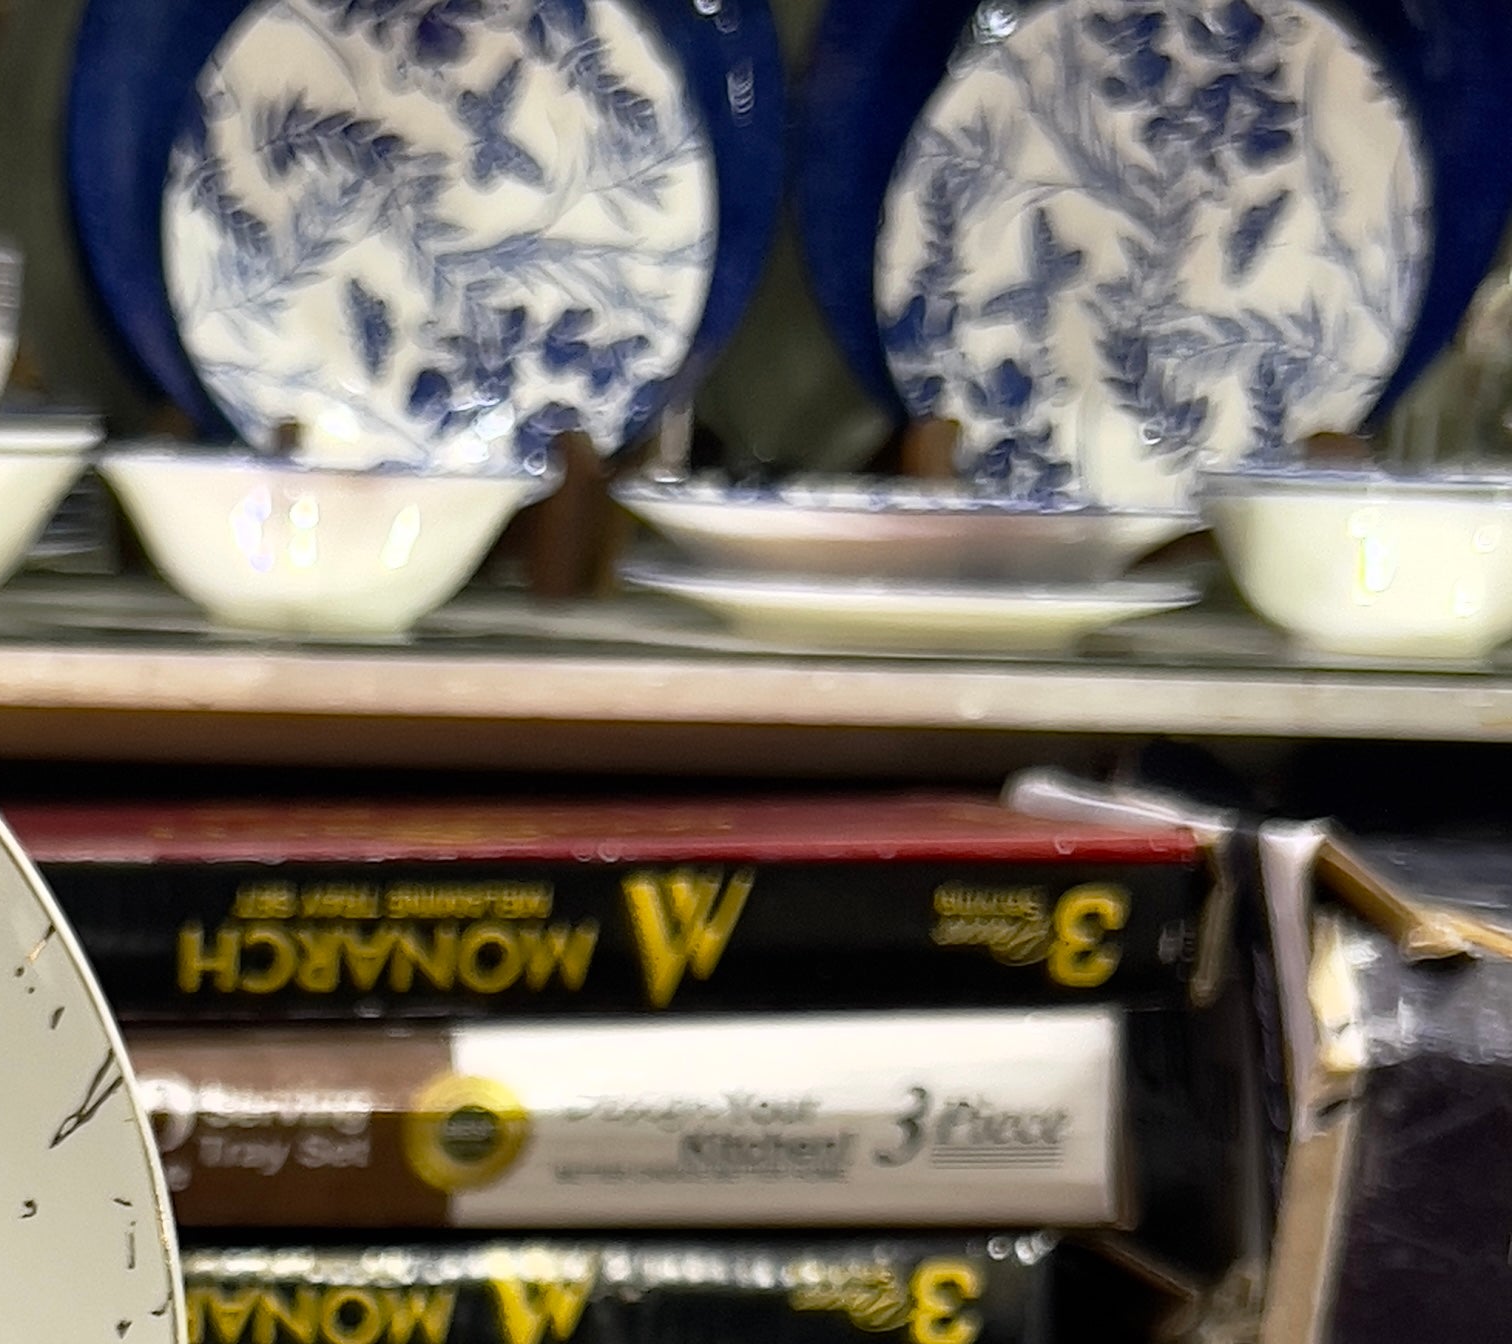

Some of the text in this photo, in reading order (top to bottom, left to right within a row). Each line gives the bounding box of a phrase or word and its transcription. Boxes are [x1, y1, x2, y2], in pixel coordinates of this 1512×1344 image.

[177, 921, 599, 995] MONARCH
[1048, 883, 1131, 988] 3
[872, 1085, 931, 1168] 3
